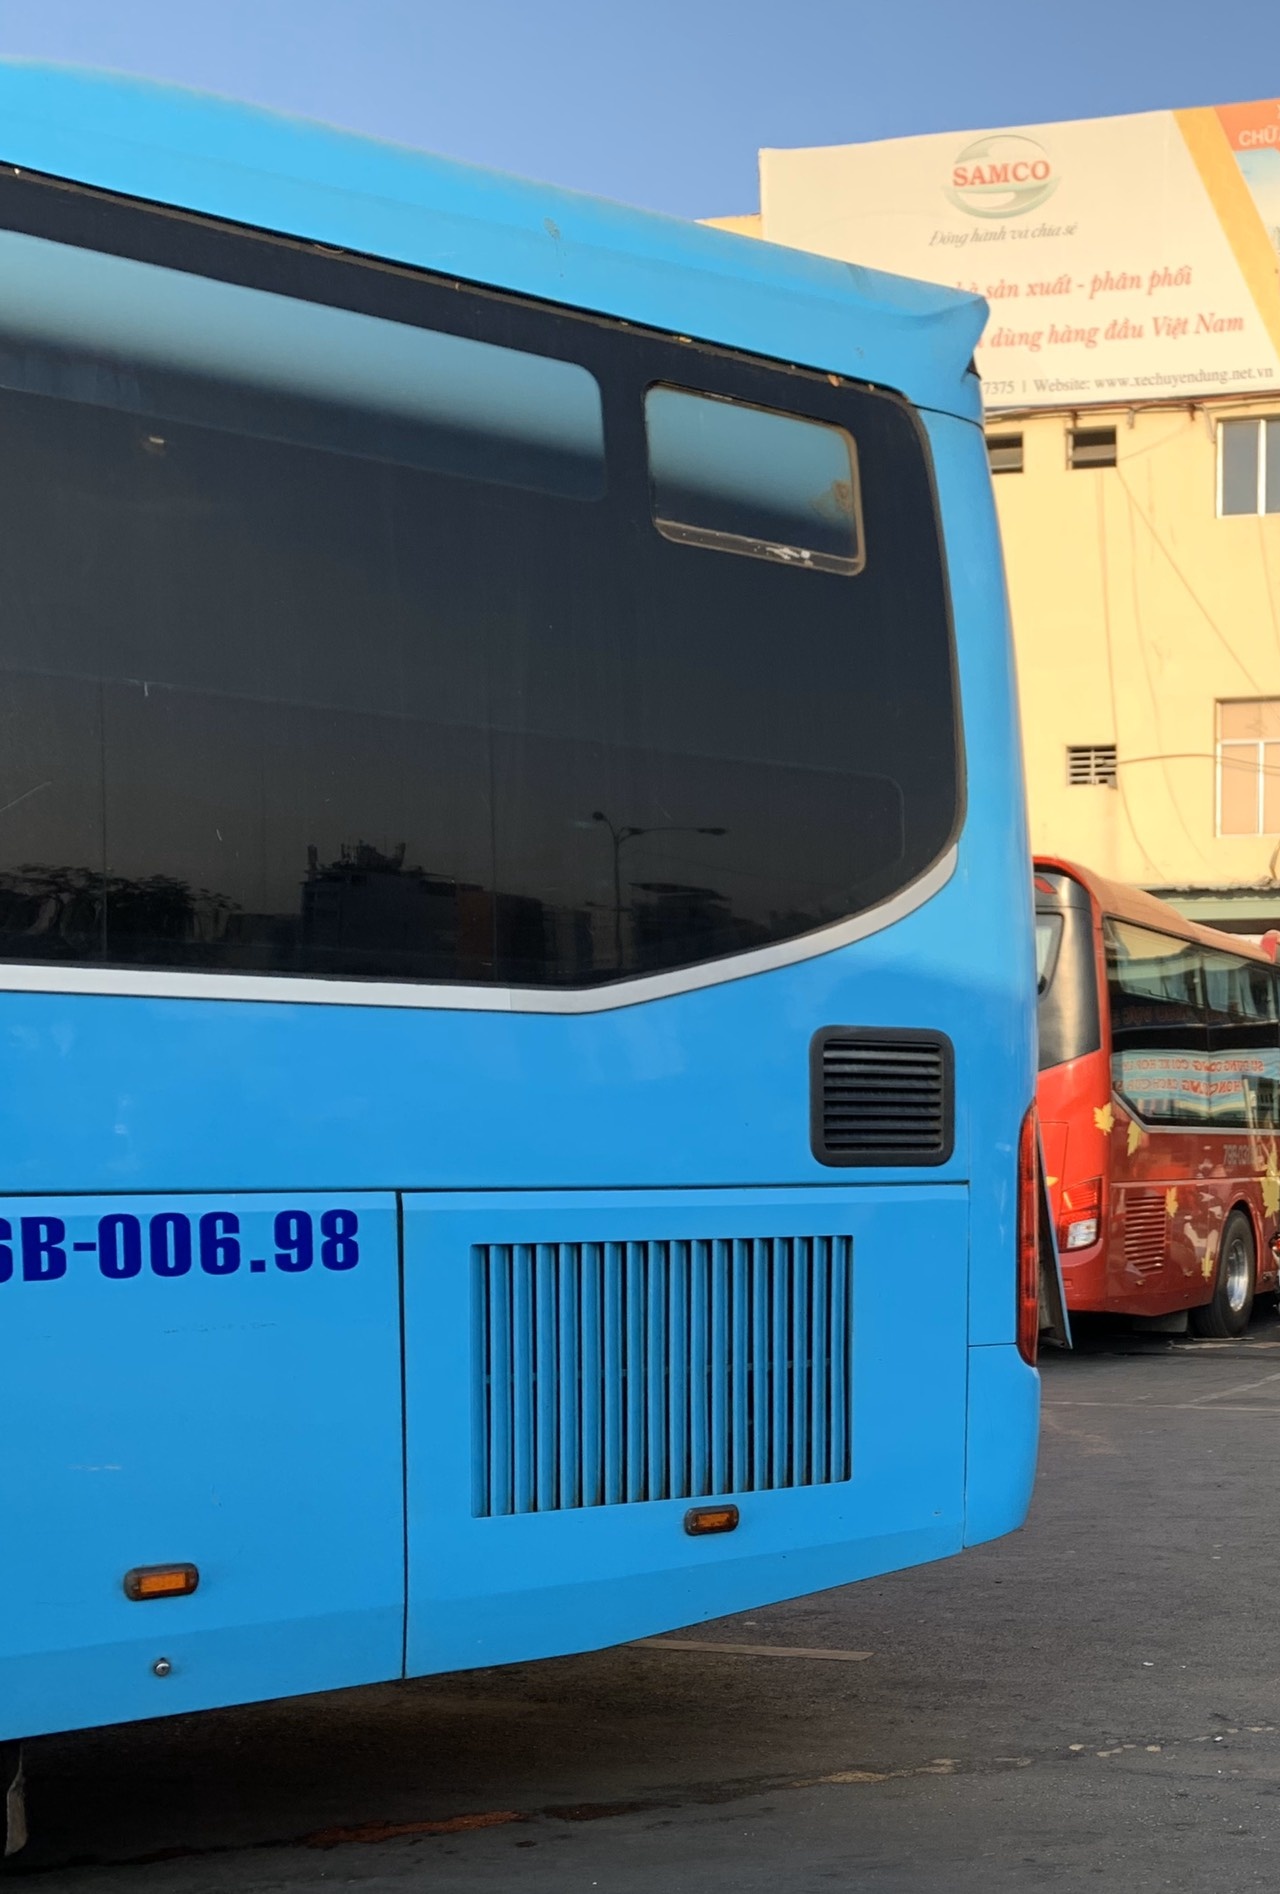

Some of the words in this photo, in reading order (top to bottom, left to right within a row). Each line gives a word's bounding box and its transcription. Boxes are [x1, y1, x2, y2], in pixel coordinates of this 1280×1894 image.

[952, 159, 1052, 187] SAMCO
[991, 326, 1043, 352] dùng
[1047, 323, 1100, 350] hàng
[1152, 313, 1191, 341] Việt
[1194, 312, 1245, 335] Nam
[1033, 376, 1091, 394] Website:
